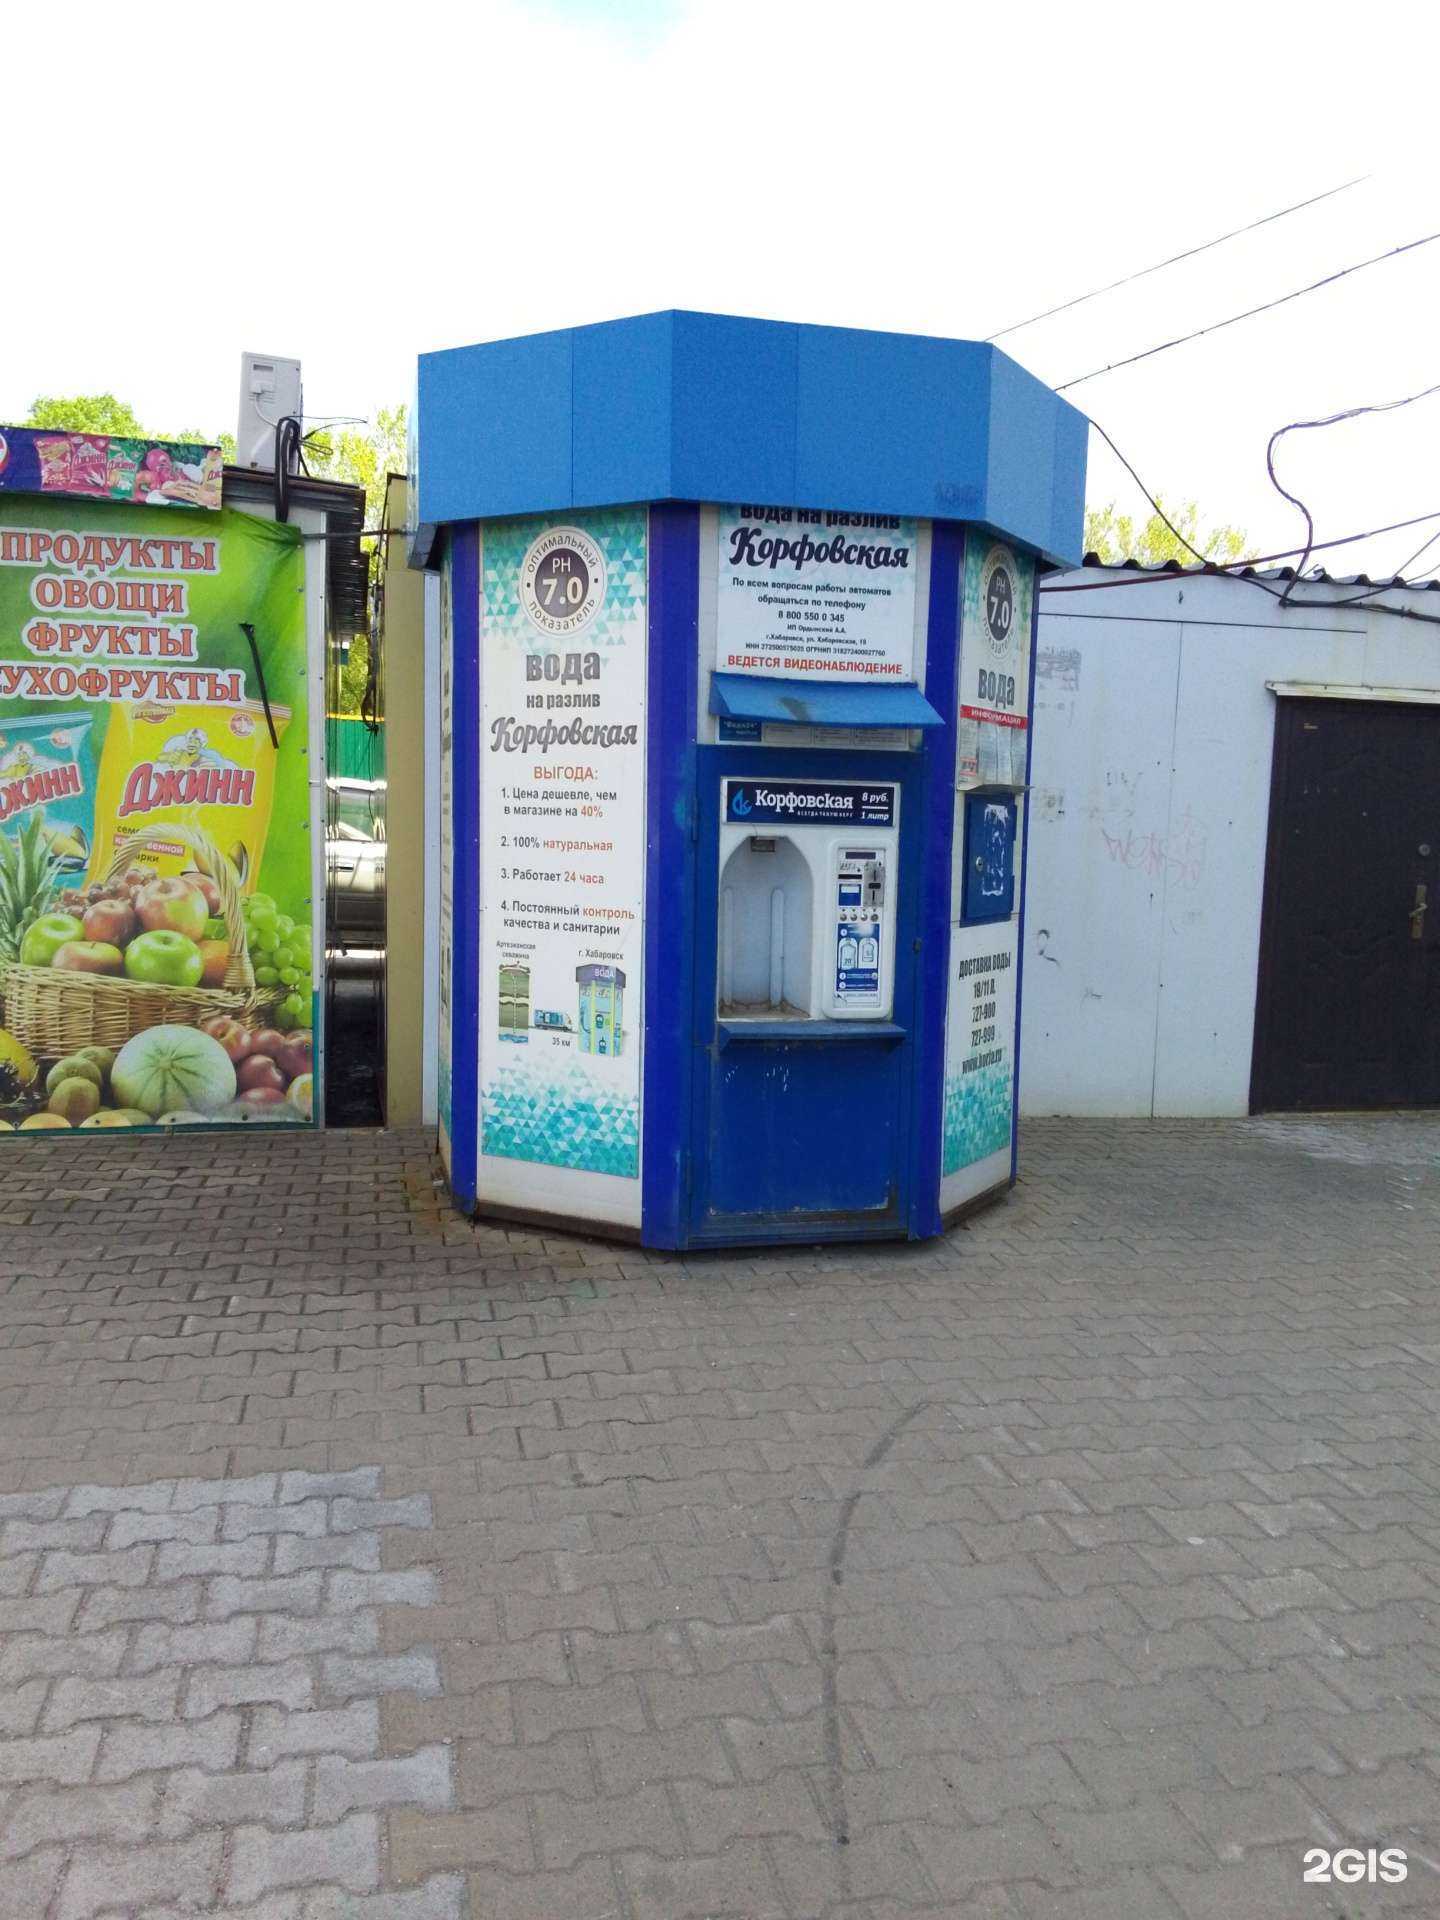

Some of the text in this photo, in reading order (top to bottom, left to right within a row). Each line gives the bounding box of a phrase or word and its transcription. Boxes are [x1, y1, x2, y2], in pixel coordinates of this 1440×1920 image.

[1, 531, 216, 572] ПРОДУКТЫ
[729, 526, 909, 570] Корфовская
[35, 578, 183, 618] ОВОЩИ
[542, 576, 583, 606] 7.0
[732, 577, 891, 596] По всем вопросам работы автоматов
[529, 598, 595, 630] показатель
[757, 595, 809, 605] обращаться
[824, 598, 866, 610] телефону
[990, 596, 1009, 629] 7.0
[778, 611, 845, 622] 8 800 550 0 345
[28, 622, 193, 656] ФРУКТЫ
[526, 652, 600, 685] вода
[728, 655, 902, 674] ВЕДЕТСЯ ВИДЕОНАБЛЮДЕНИЕ
[0, 665, 241, 701] УХОФРУКТЫ
[978, 668, 1015, 709] вода
[527, 694, 600, 710] на разлив
[490, 717, 638, 753] Корфовская
[534, 767, 598, 782] ВЫГОДА:
[119, 763, 255, 816] Джинн
[502, 788, 617, 802] 1. Цена дешевле, чем
[755, 789, 854, 813] Корфовская
[504, 806, 603, 818] в магазине на 40%
[501, 836, 613, 852] 2. 100% натуральная
[501, 868, 604, 884] 3. Работает 24 часа
[501, 900, 635, 920] 4. Постоянный контроль
[504, 918, 620, 936] качества и санитарии
[959, 951, 1011, 981] ДОСТАВКА ВОДЫ
[972, 1001, 996, 1023] 727-900
